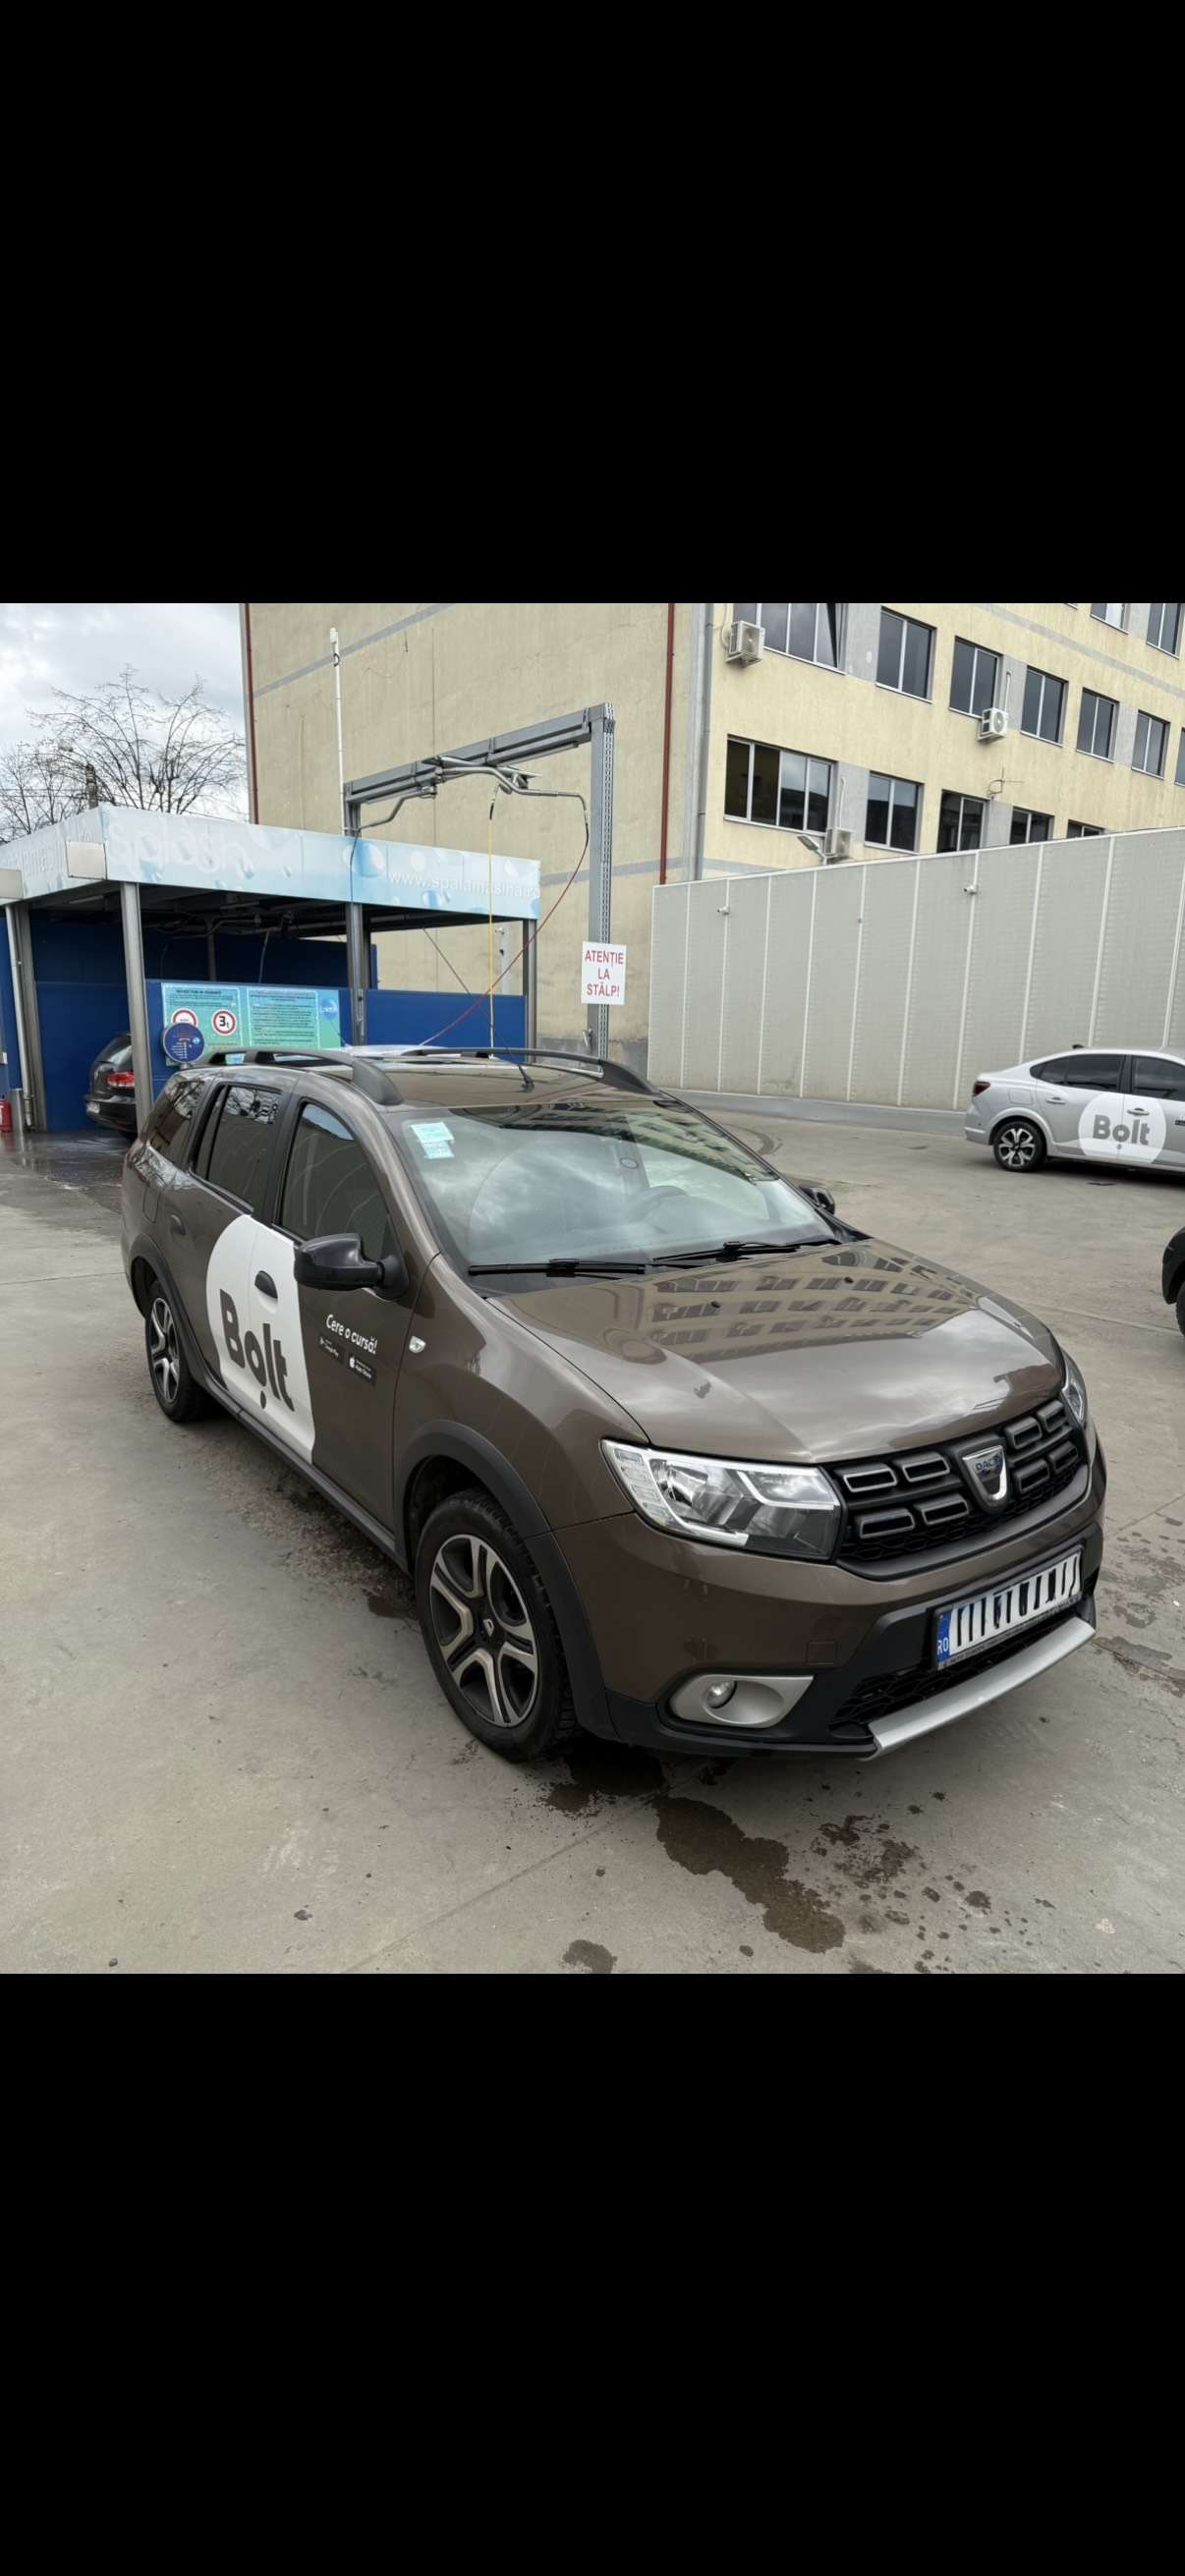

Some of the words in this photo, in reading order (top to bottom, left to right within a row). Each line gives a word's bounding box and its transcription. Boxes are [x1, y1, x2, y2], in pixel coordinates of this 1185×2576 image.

[597, 968, 610, 980] LA
[1093, 1114, 1151, 1148] Bolt
[219, 1289, 295, 1412] Bolt
[326, 1314, 345, 1336] Cere
[345, 1328, 351, 1339] o
[351, 1331, 378, 1355] cursă!
[937, 1637, 949, 1656] RO
